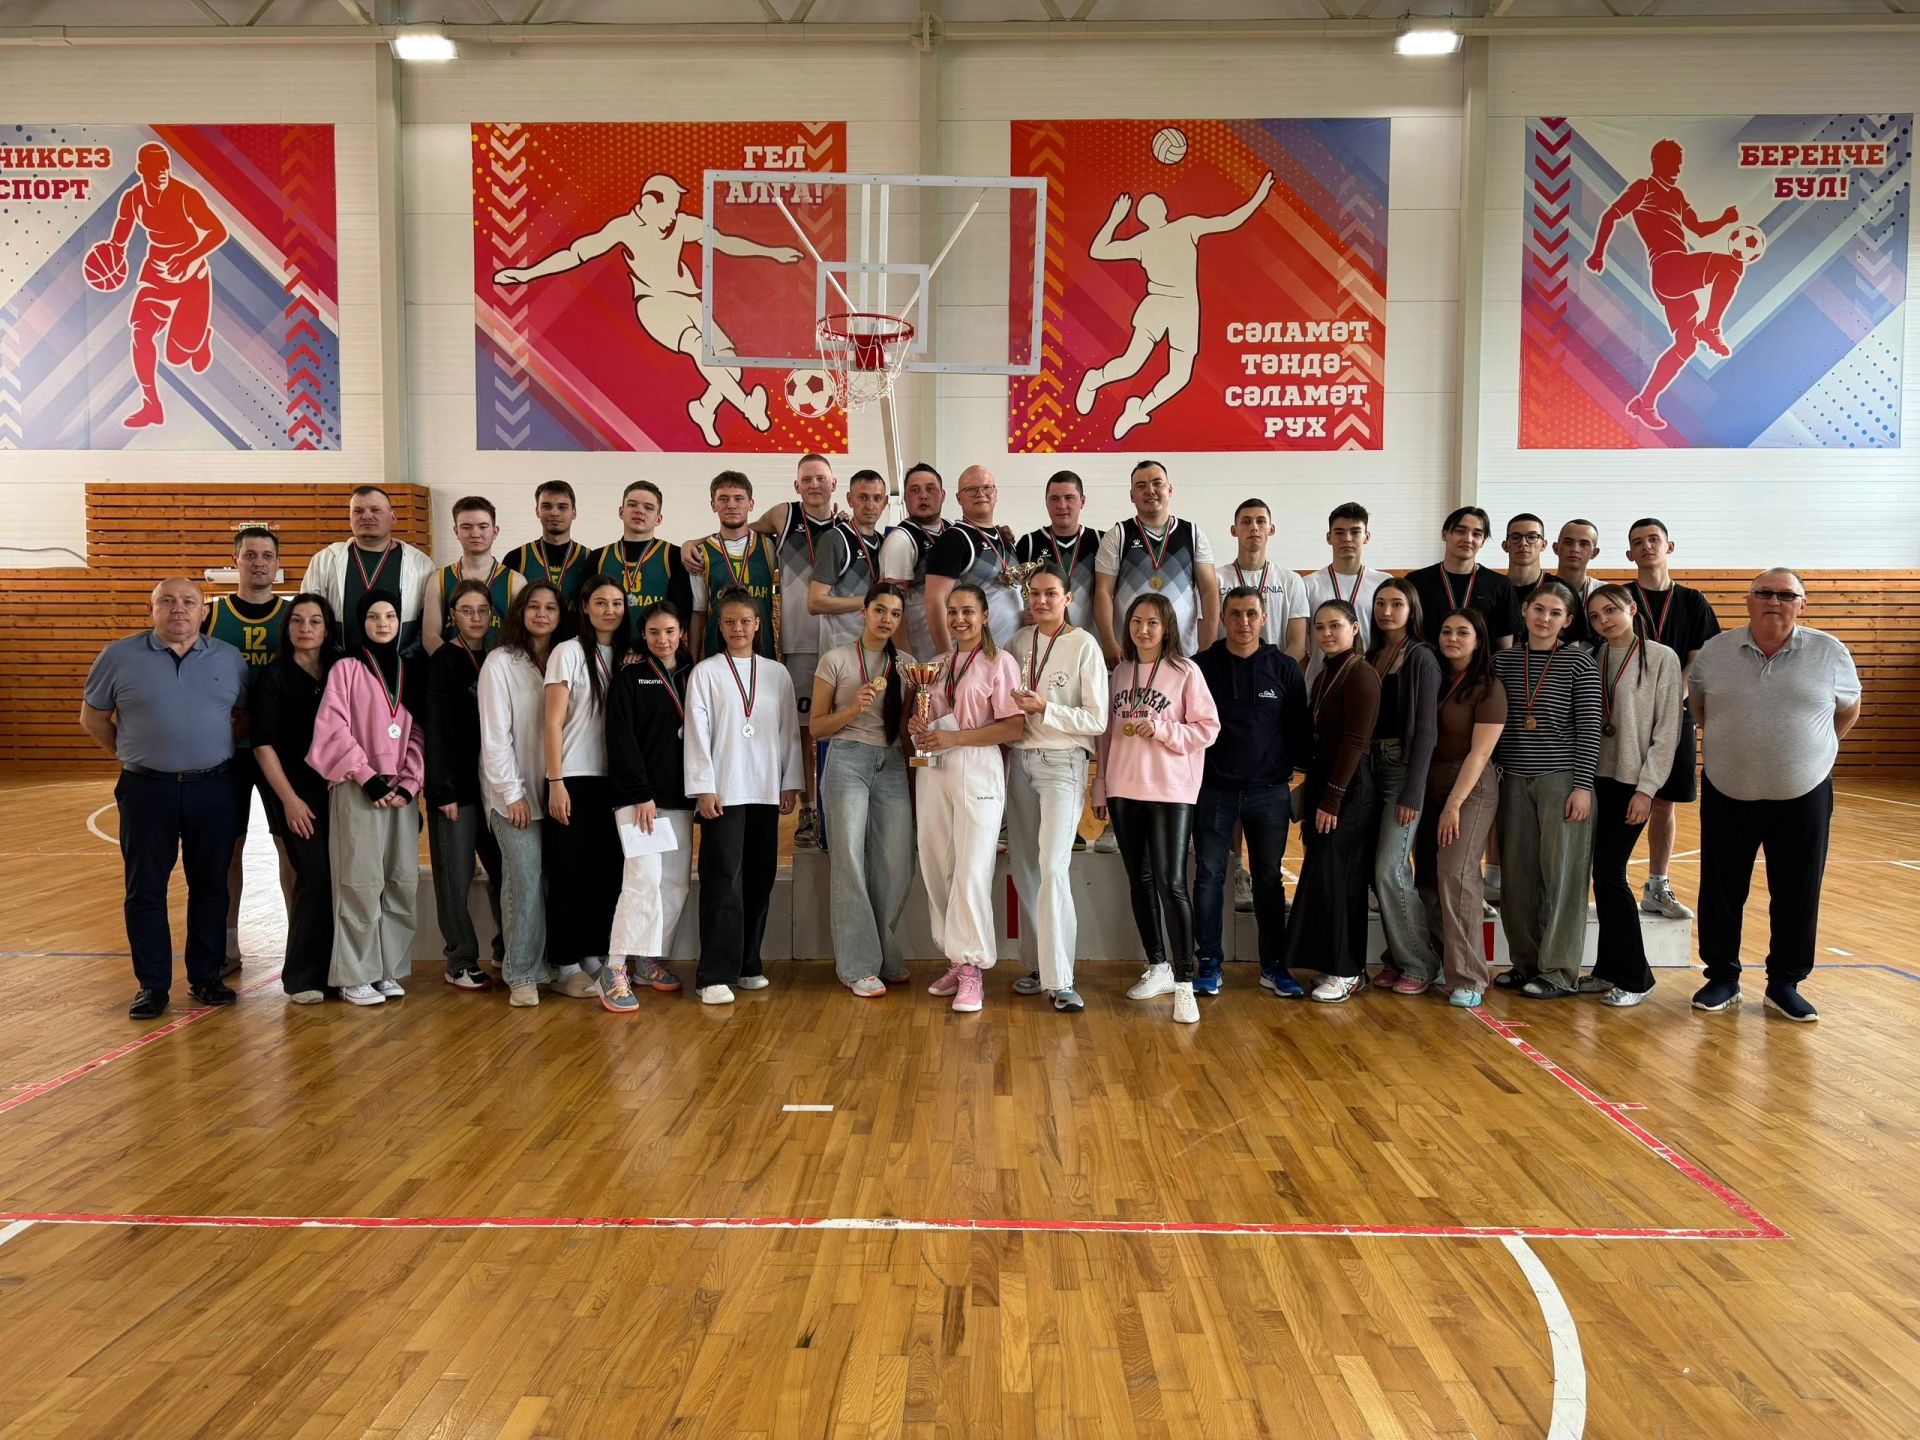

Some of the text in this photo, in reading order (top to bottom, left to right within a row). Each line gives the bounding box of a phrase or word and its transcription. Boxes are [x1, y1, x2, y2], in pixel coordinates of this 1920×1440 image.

[744, 146, 805, 168] ГЕЛ
[1740, 144, 1884, 166] БЕРЕНЧЕ
[0, 179, 89, 199] СПОРТ
[726, 181, 823, 203] АЛГА!
[1774, 177, 1847, 198] БУЛ!
[1226, 321, 1369, 343] СӘЛАМӘТ
[1241, 353, 1352, 378] ТӘНДӘ-
[1225, 384, 1368, 407] СӘЛАМӘТ
[1264, 416, 1327, 438] РУХ
[242, 626, 268, 650] 12
